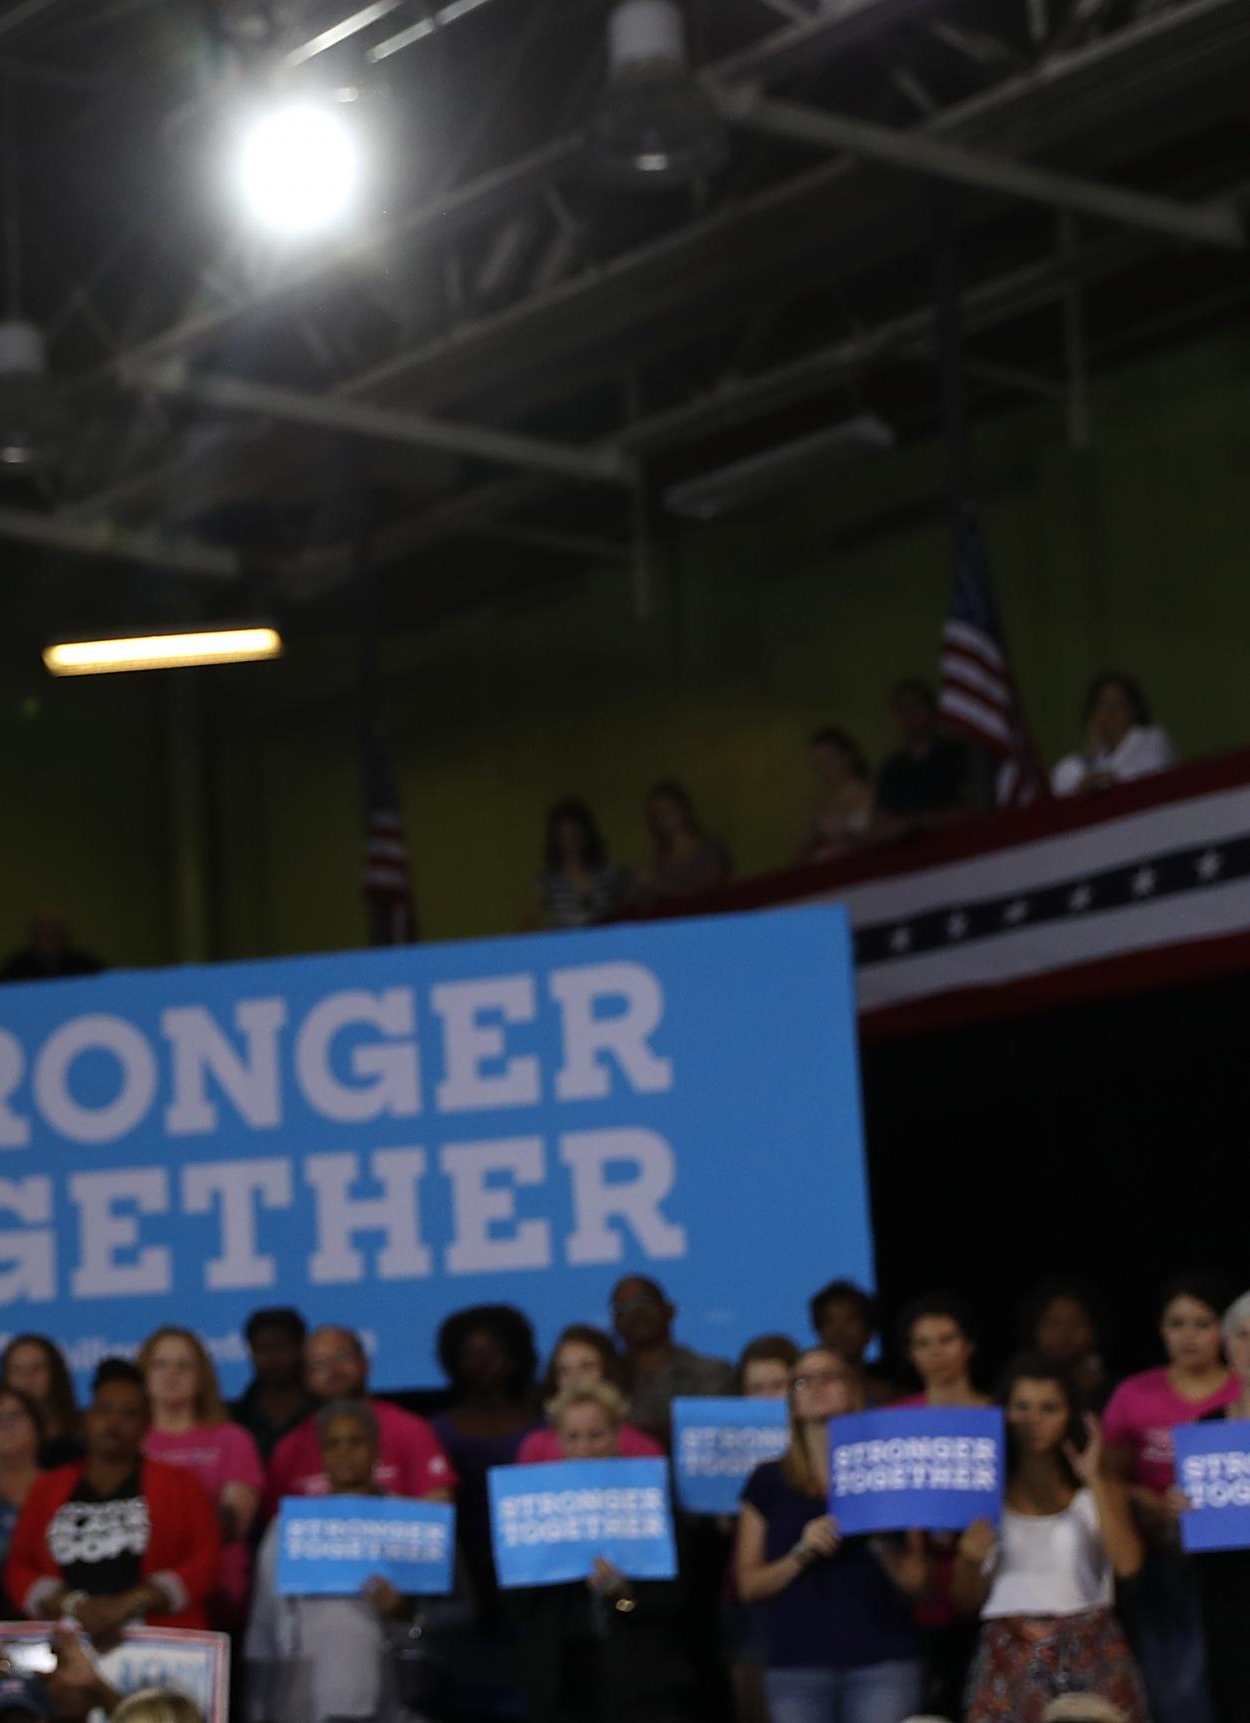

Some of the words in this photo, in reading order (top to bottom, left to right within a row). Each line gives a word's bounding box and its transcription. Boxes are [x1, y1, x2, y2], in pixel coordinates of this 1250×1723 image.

[833, 1437, 996, 1471] STRONGER
[834, 1464, 997, 1497] TOGETHER
[501, 1488, 664, 1521] STRONGER
[286, 1518, 447, 1541] STRONGER
[504, 1514, 665, 1547] TOGETHER
[288, 1538, 446, 1563] TOGETHER
